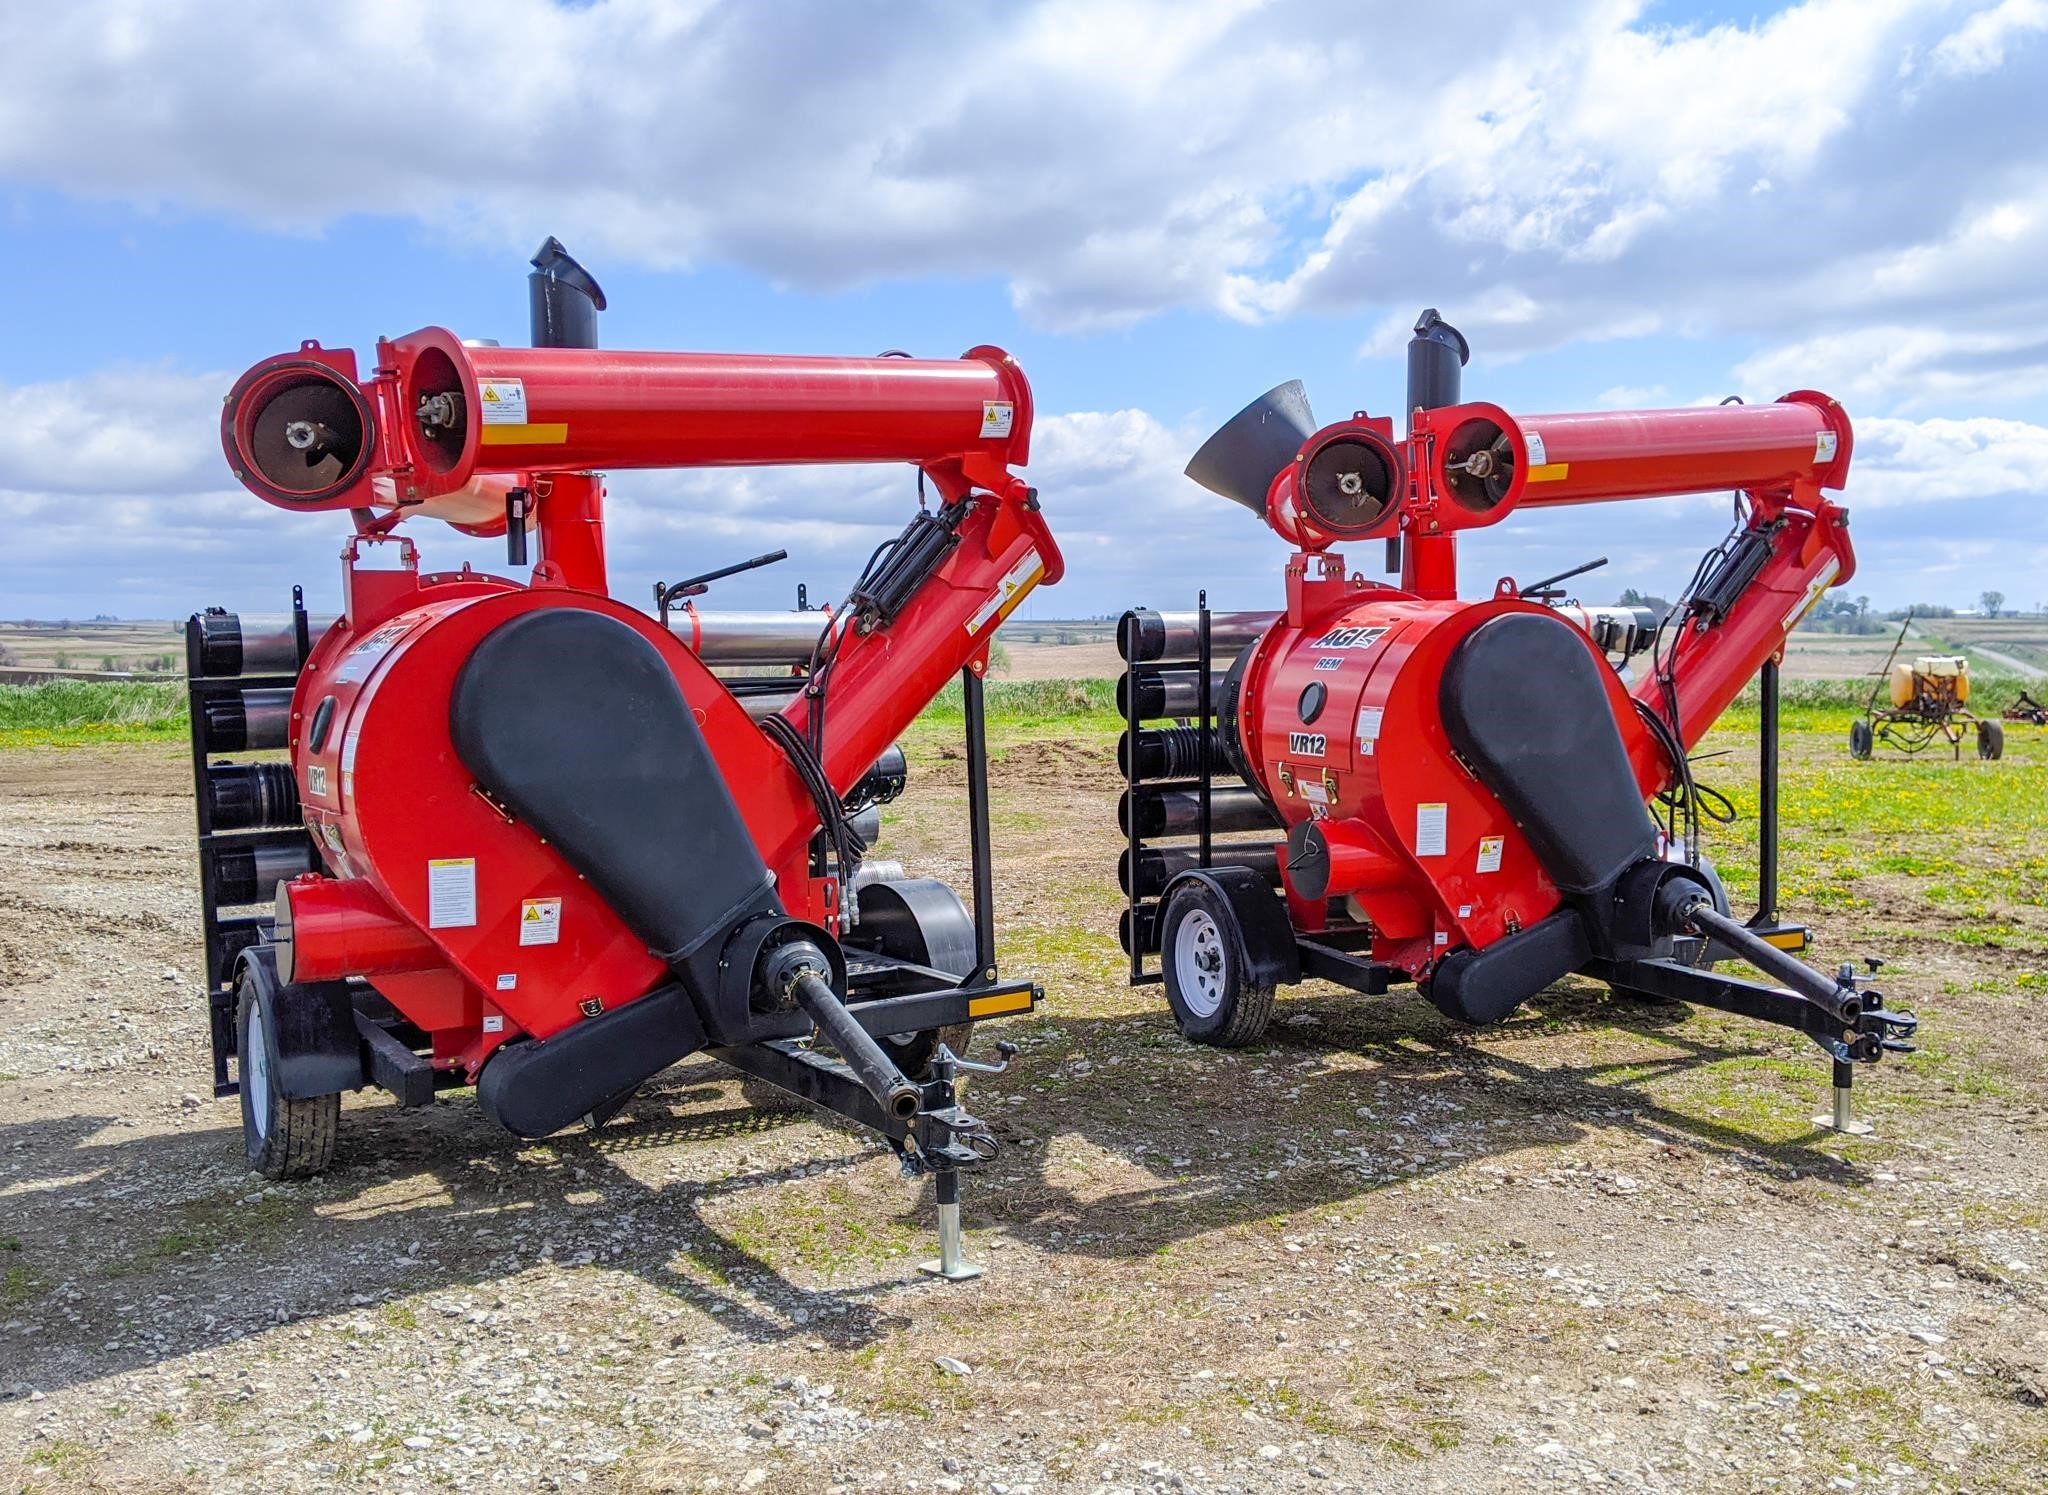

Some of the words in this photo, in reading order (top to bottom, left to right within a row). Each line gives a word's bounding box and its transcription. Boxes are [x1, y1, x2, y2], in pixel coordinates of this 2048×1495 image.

[1315, 628, 1368, 647] AGI
[1316, 658, 1341, 669] REM
[1290, 733, 1325, 754] VR12
[309, 767, 325, 793] VR12
